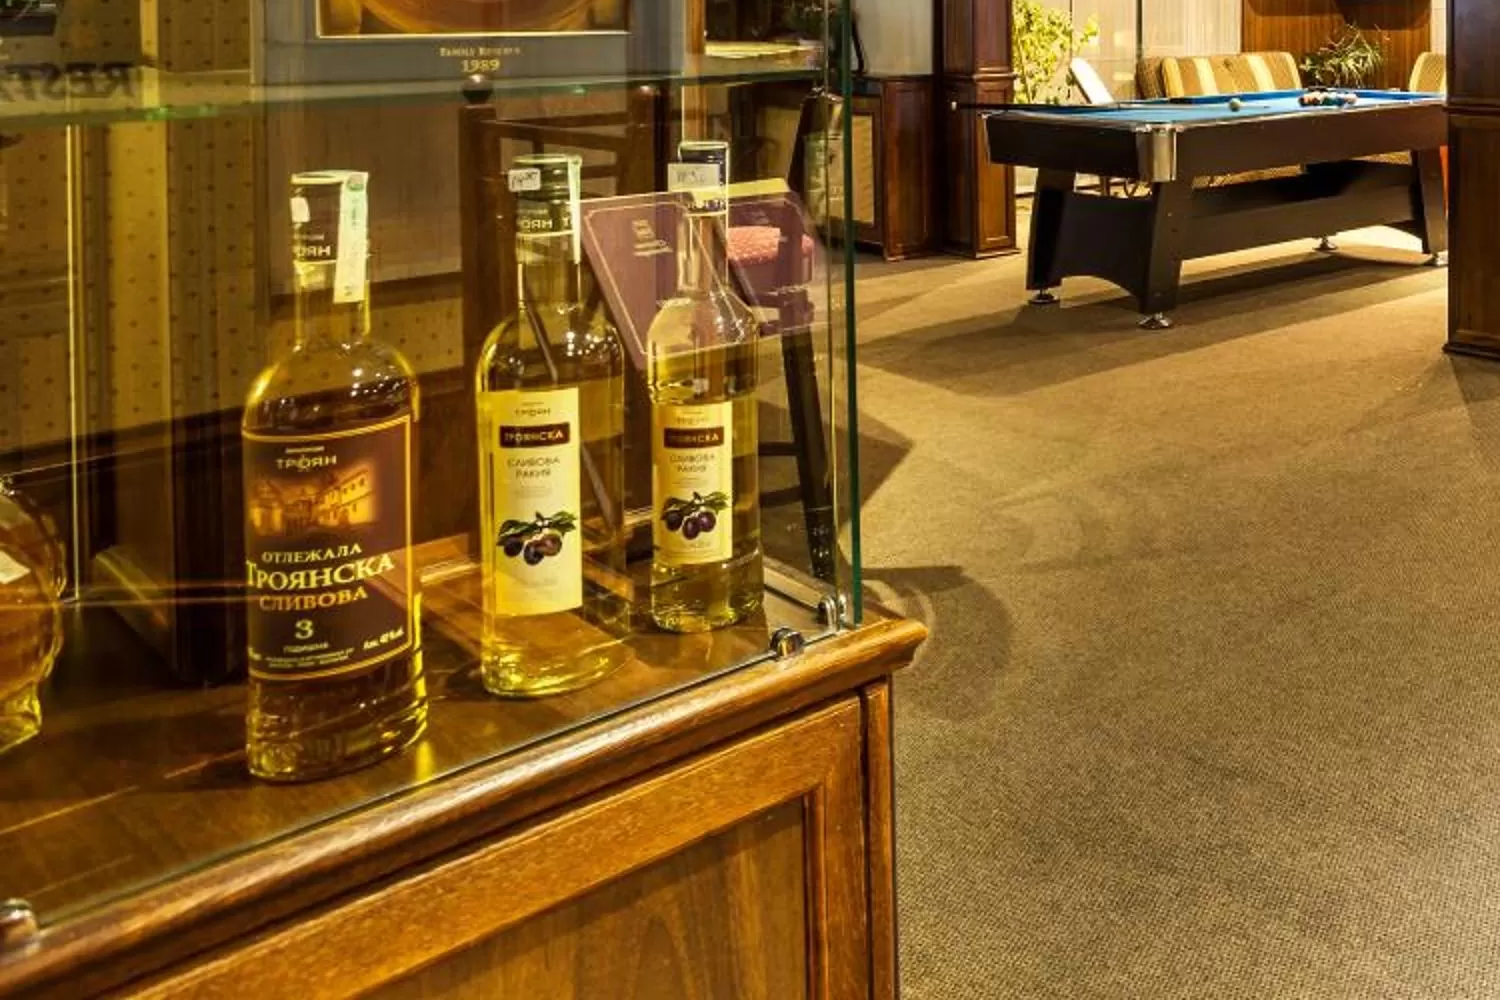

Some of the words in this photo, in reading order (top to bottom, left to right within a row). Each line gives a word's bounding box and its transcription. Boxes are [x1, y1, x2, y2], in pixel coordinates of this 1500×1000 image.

[262, 543, 362, 564] ОТЛЕЖАЛА
[245, 553, 395, 590] ТРОЯНСКА
[259, 585, 368, 612] СЛИВОВА
[294, 619, 315, 640] 3
